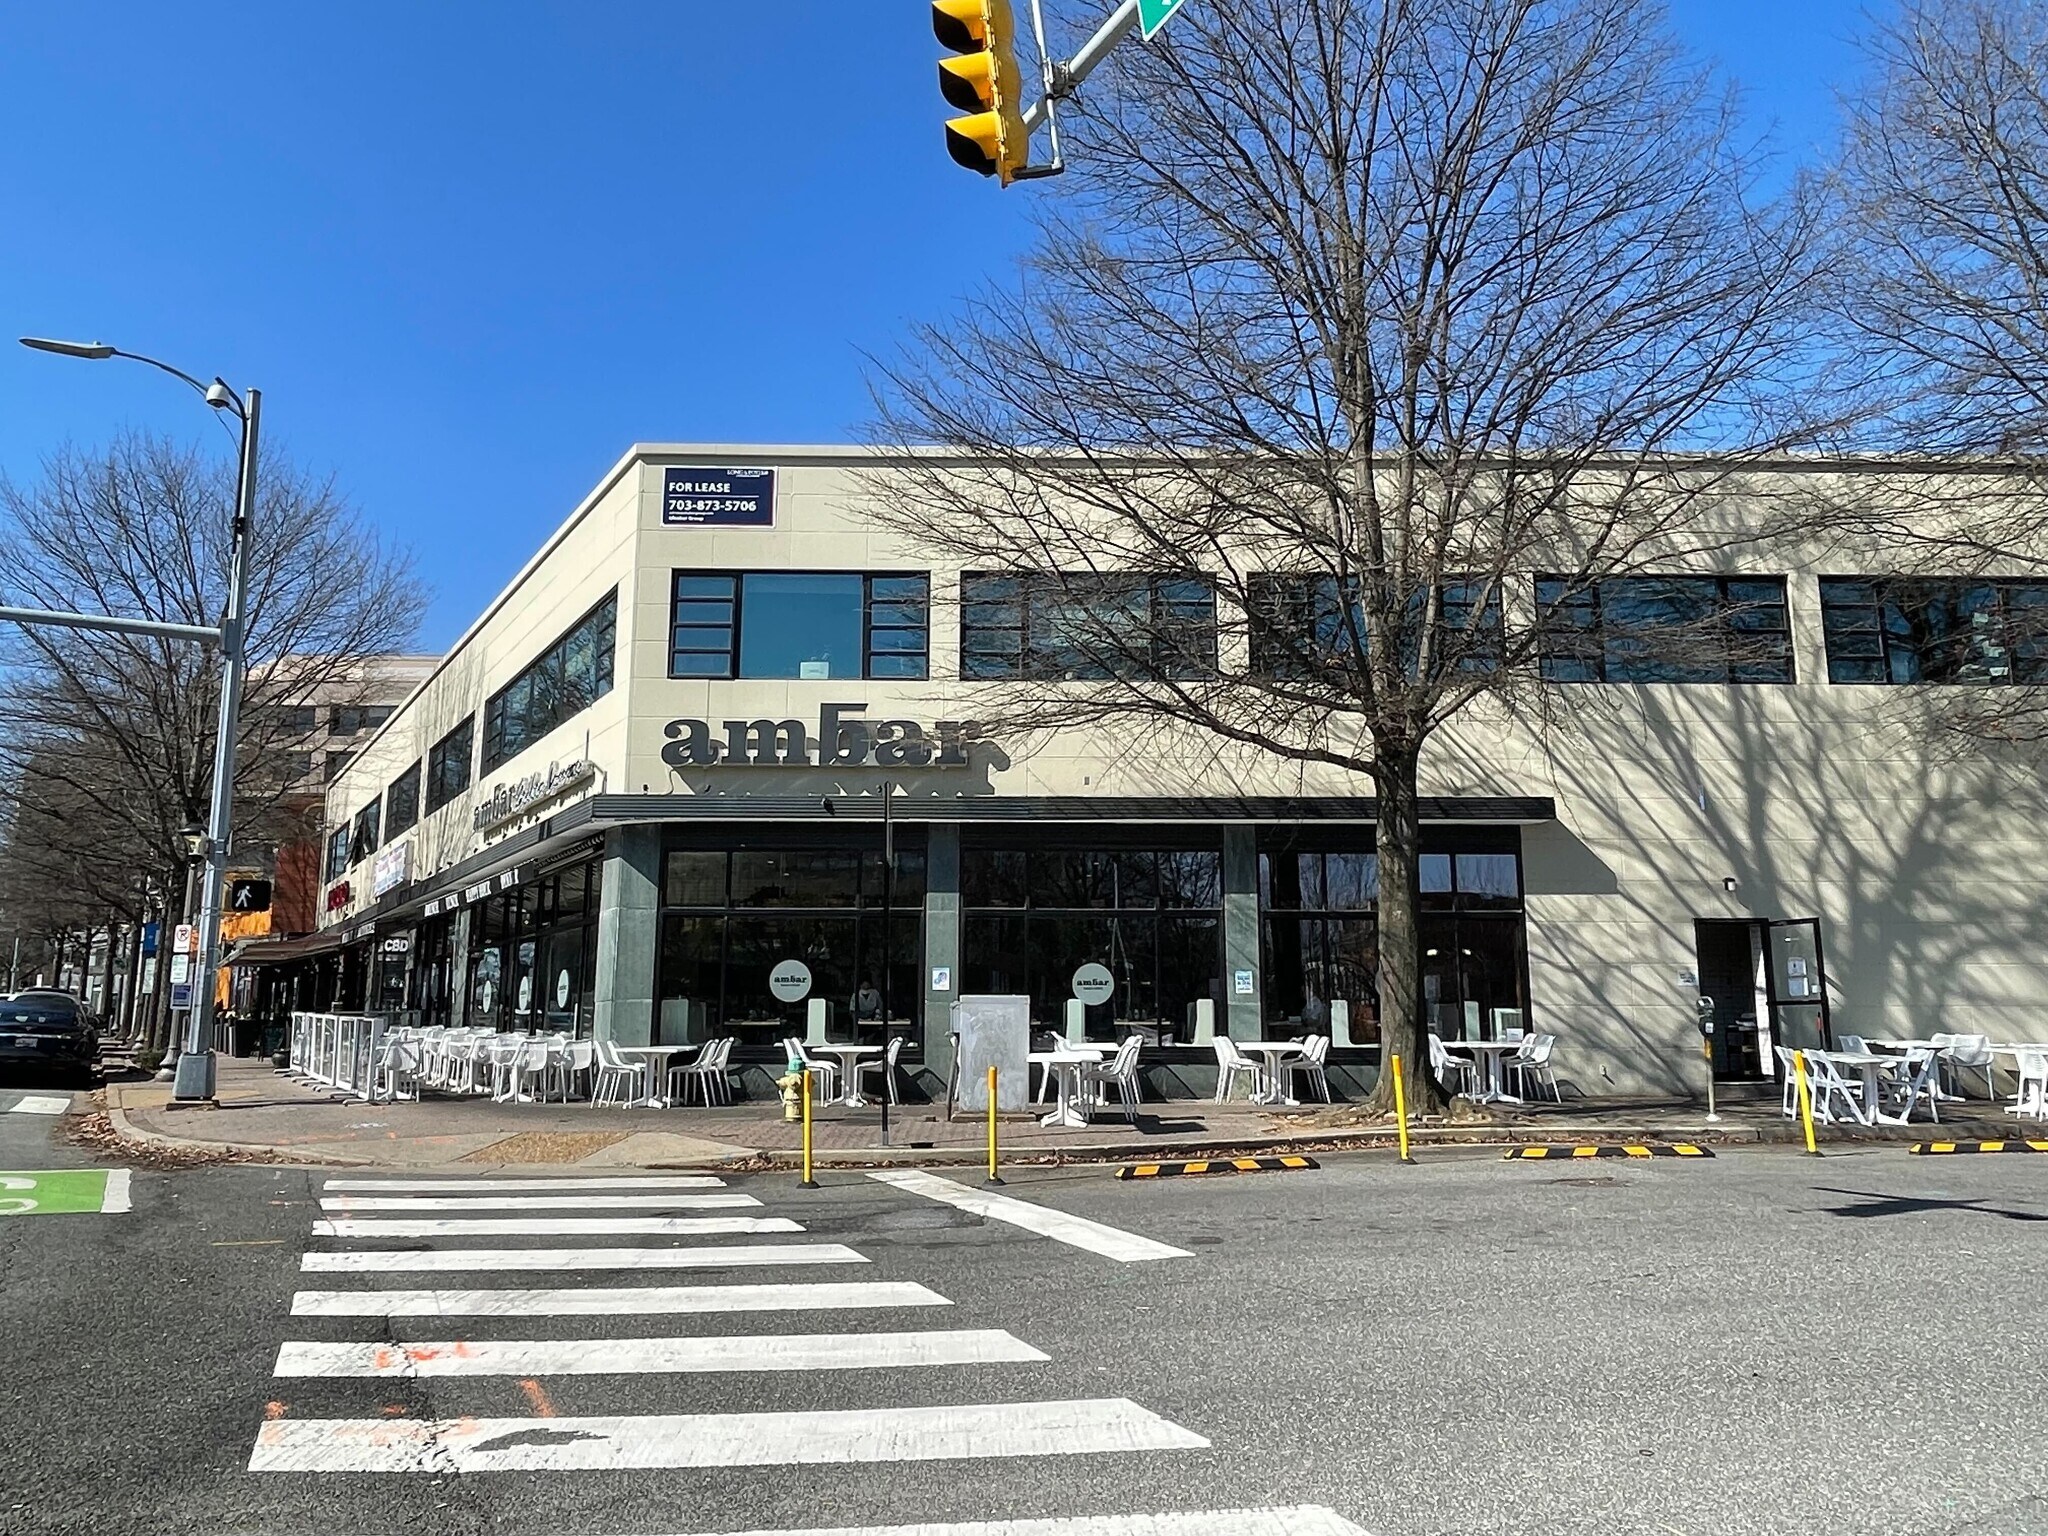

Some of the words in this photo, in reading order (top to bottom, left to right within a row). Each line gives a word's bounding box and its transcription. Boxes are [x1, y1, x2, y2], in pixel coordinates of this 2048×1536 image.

[668, 482, 693, 492] FOR
[694, 482, 731, 493] LEASE
[668, 500, 757, 511] 703-873-5706
[385, 939, 409, 952] CBD
